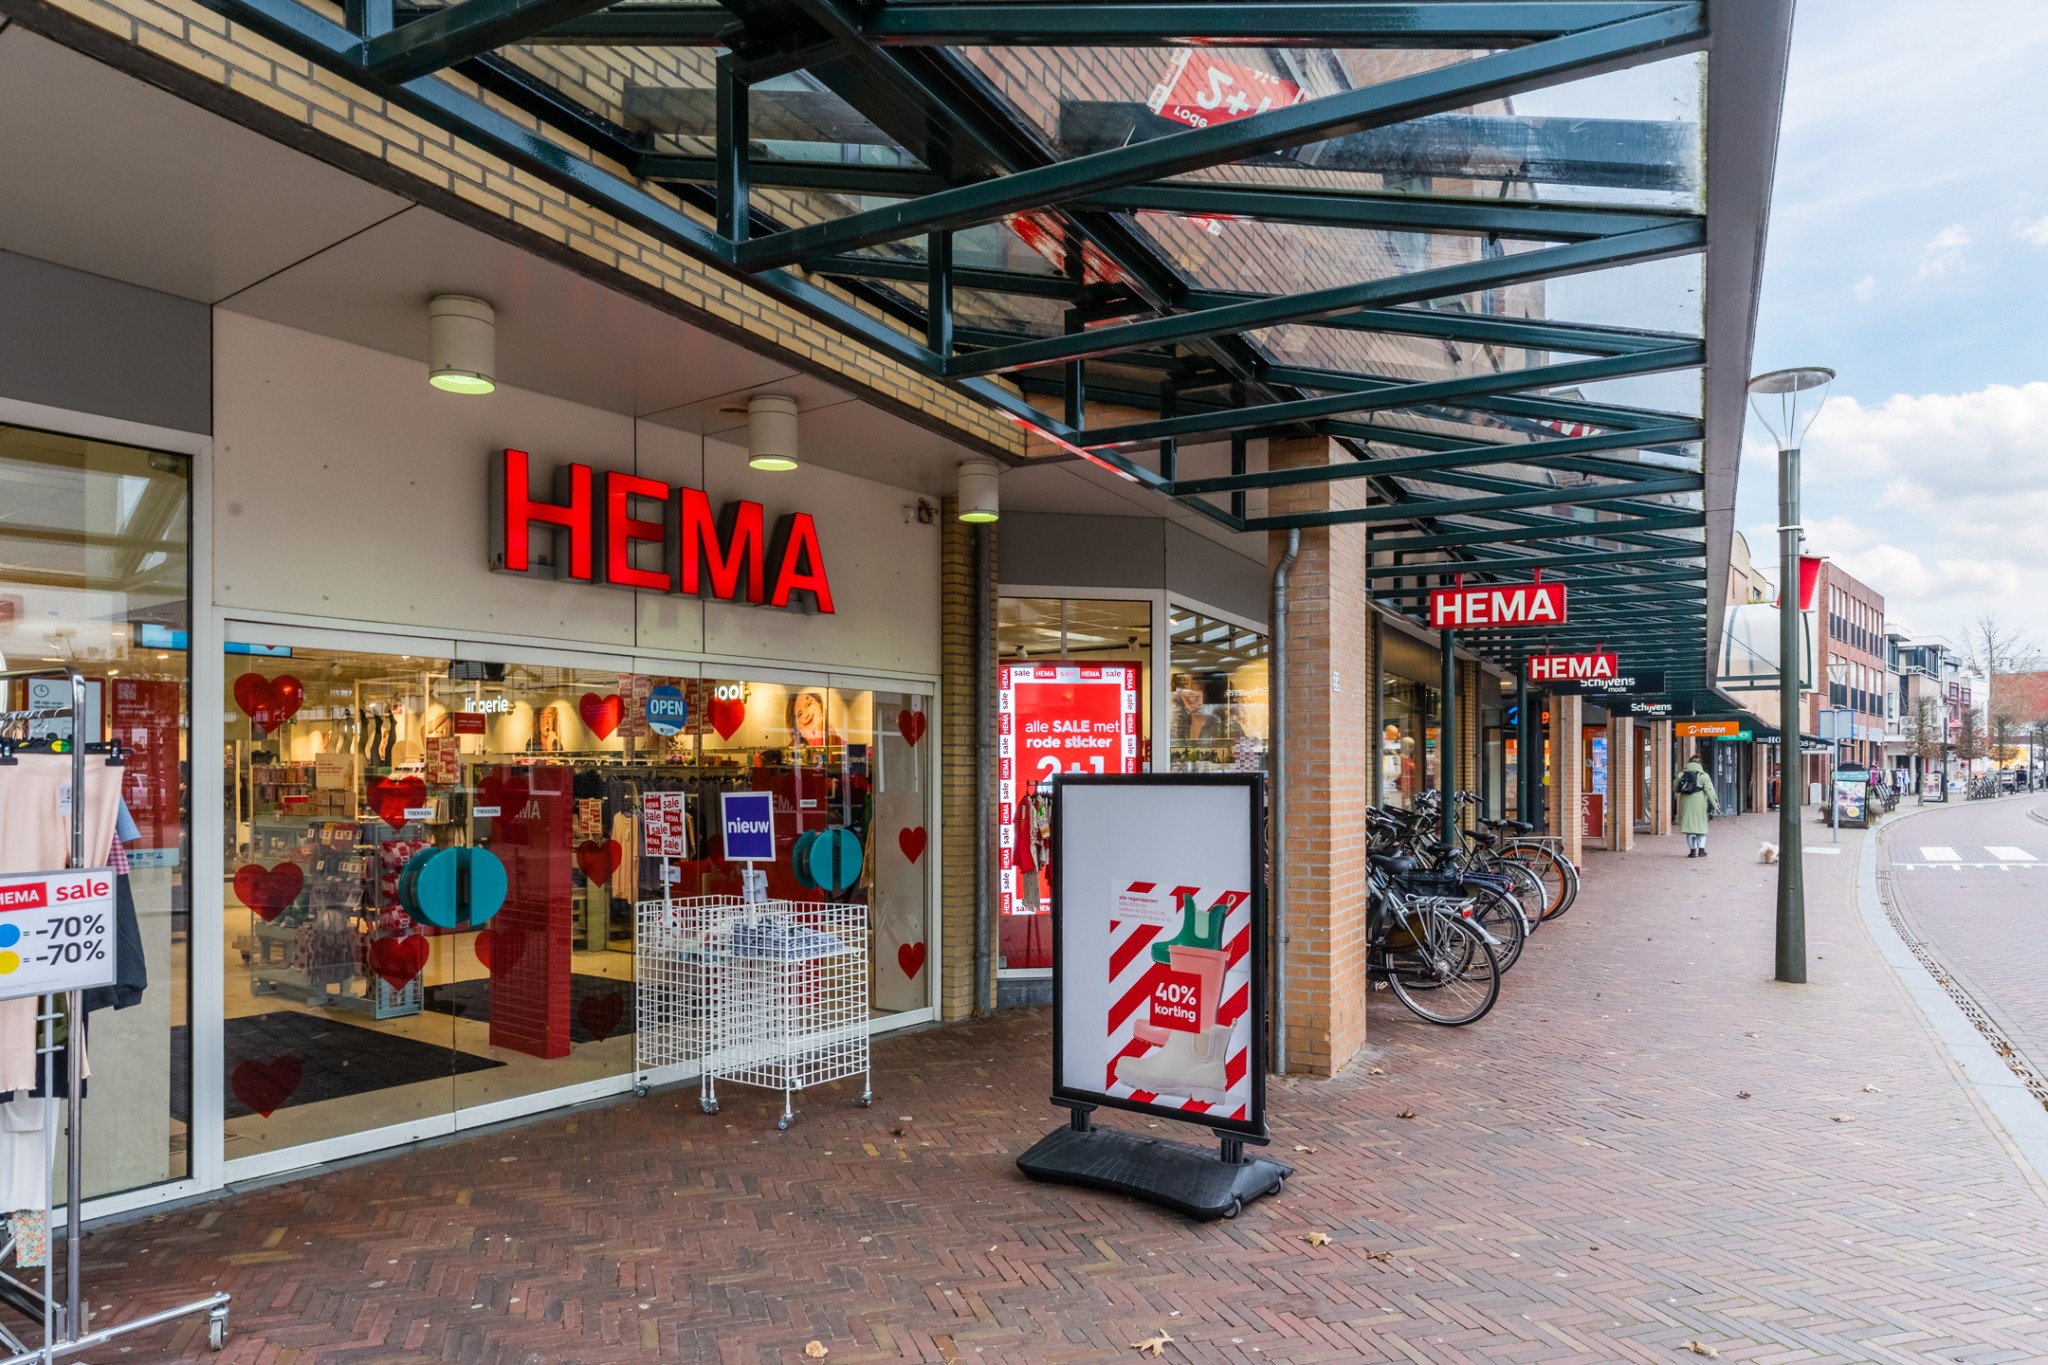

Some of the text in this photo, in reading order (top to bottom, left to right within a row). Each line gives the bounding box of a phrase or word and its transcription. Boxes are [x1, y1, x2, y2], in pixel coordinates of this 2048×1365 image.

[503, 447, 835, 615] HEMA
[1436, 588, 1557, 625] HEMA
[1014, 669, 1031, 677] sale
[1532, 656, 1612, 679] HEMA
[1580, 677, 1635, 689] Schijvens
[650, 699, 684, 716] OPEN
[1631, 703, 1672, 713] Schijvens
[1025, 720, 1121, 733] alle SALE met
[1687, 725, 1726, 735] D-reizen
[1026, 735, 1113, 749] rode sticker
[1036, 755, 1105, 783] 2+1
[515, 800, 541, 819] MA
[663, 797, 680, 809] sale
[406, 809, 432, 817] TREKKEN
[645, 811, 662, 822] sale
[1581, 796, 1590, 836] SALE
[651, 824, 668, 835] sale
[727, 817, 770, 835] nieuw
[663, 839, 680, 850] sale
[56, 878, 109, 902] sale
[36, 914, 105, 940] -70%
[36, 939, 105, 966] -70%
[1155, 982, 1197, 1006] 40%
[1155, 1003, 1197, 1023] korting
